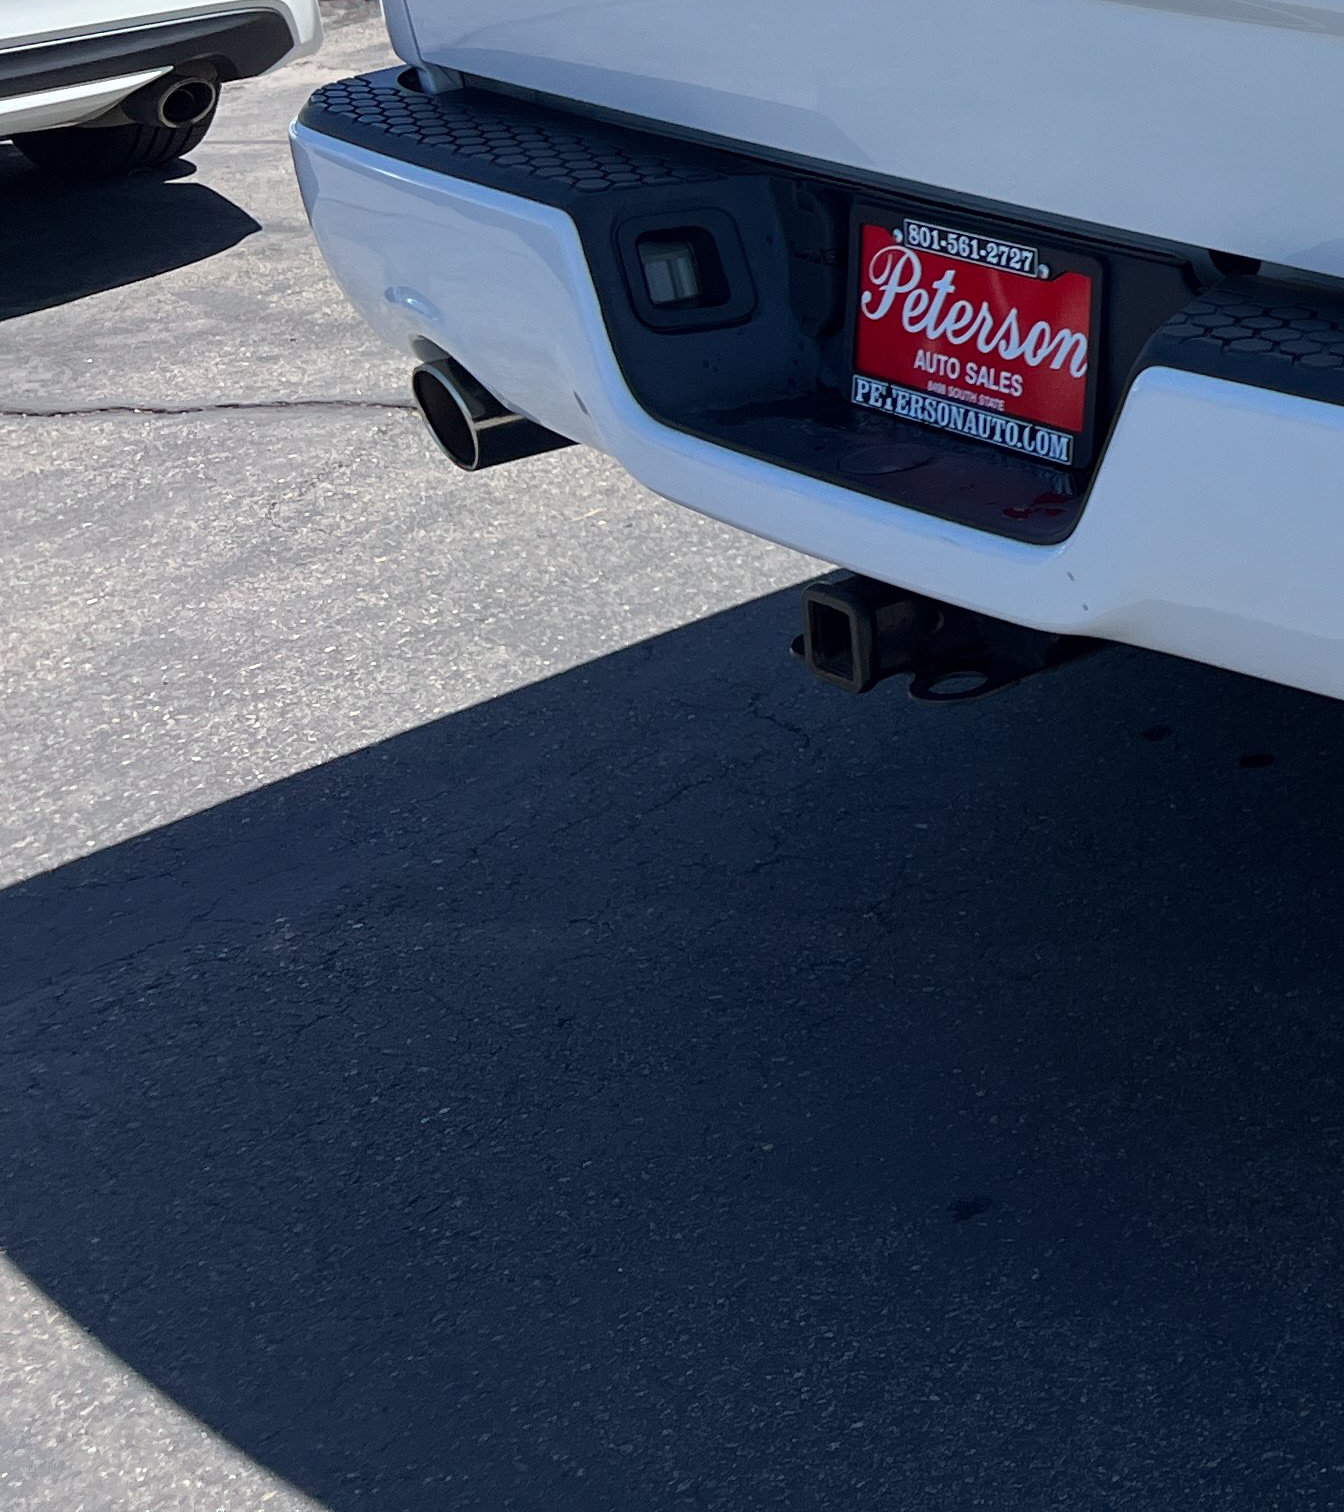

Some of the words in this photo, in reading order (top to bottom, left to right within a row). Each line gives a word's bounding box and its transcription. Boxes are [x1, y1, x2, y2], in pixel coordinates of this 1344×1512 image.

[907, 223, 1034, 272] 801-561-2727
[861, 245, 1088, 378] Peterson
[913, 349, 960, 380] AUTO
[964, 361, 1023, 397] SALES
